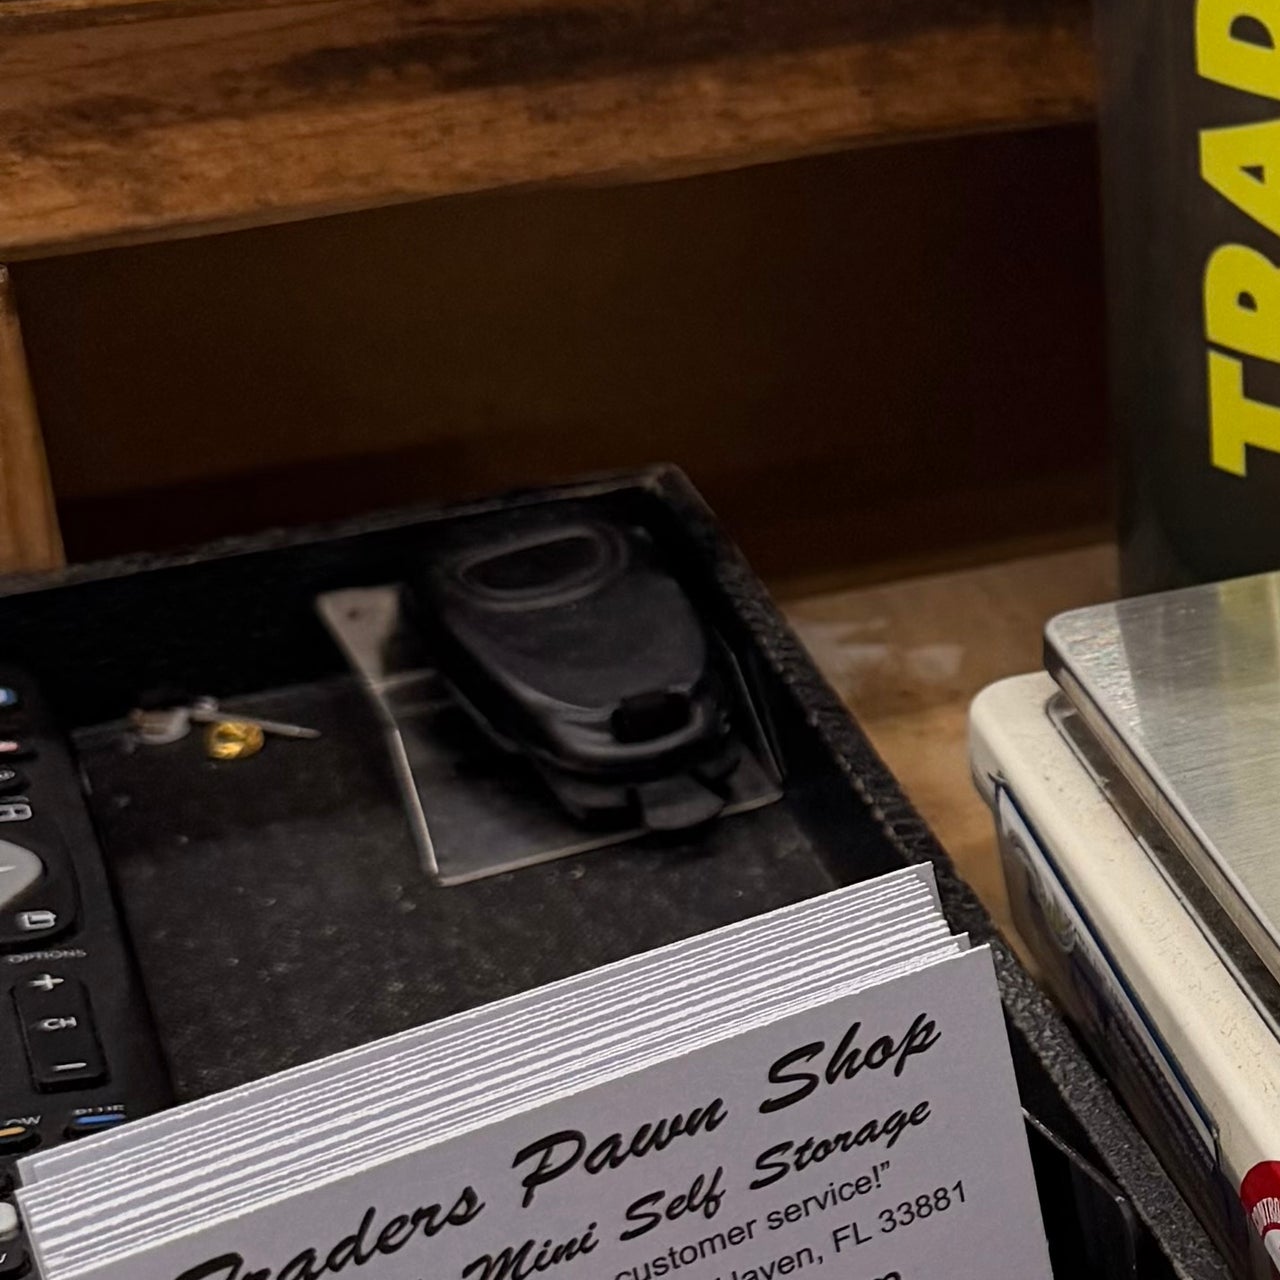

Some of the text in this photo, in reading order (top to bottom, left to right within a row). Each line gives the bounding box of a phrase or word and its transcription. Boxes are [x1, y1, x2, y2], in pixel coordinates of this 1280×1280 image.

[511, 1098, 728, 1209] Pawn
[758, 1012, 942, 1115] Shop
[619, 1166, 727, 1242] Self
[749, 1100, 932, 1191] Storage
[831, 1220, 873, 1253] FL
[878, 1179, 967, 1234] 33881
